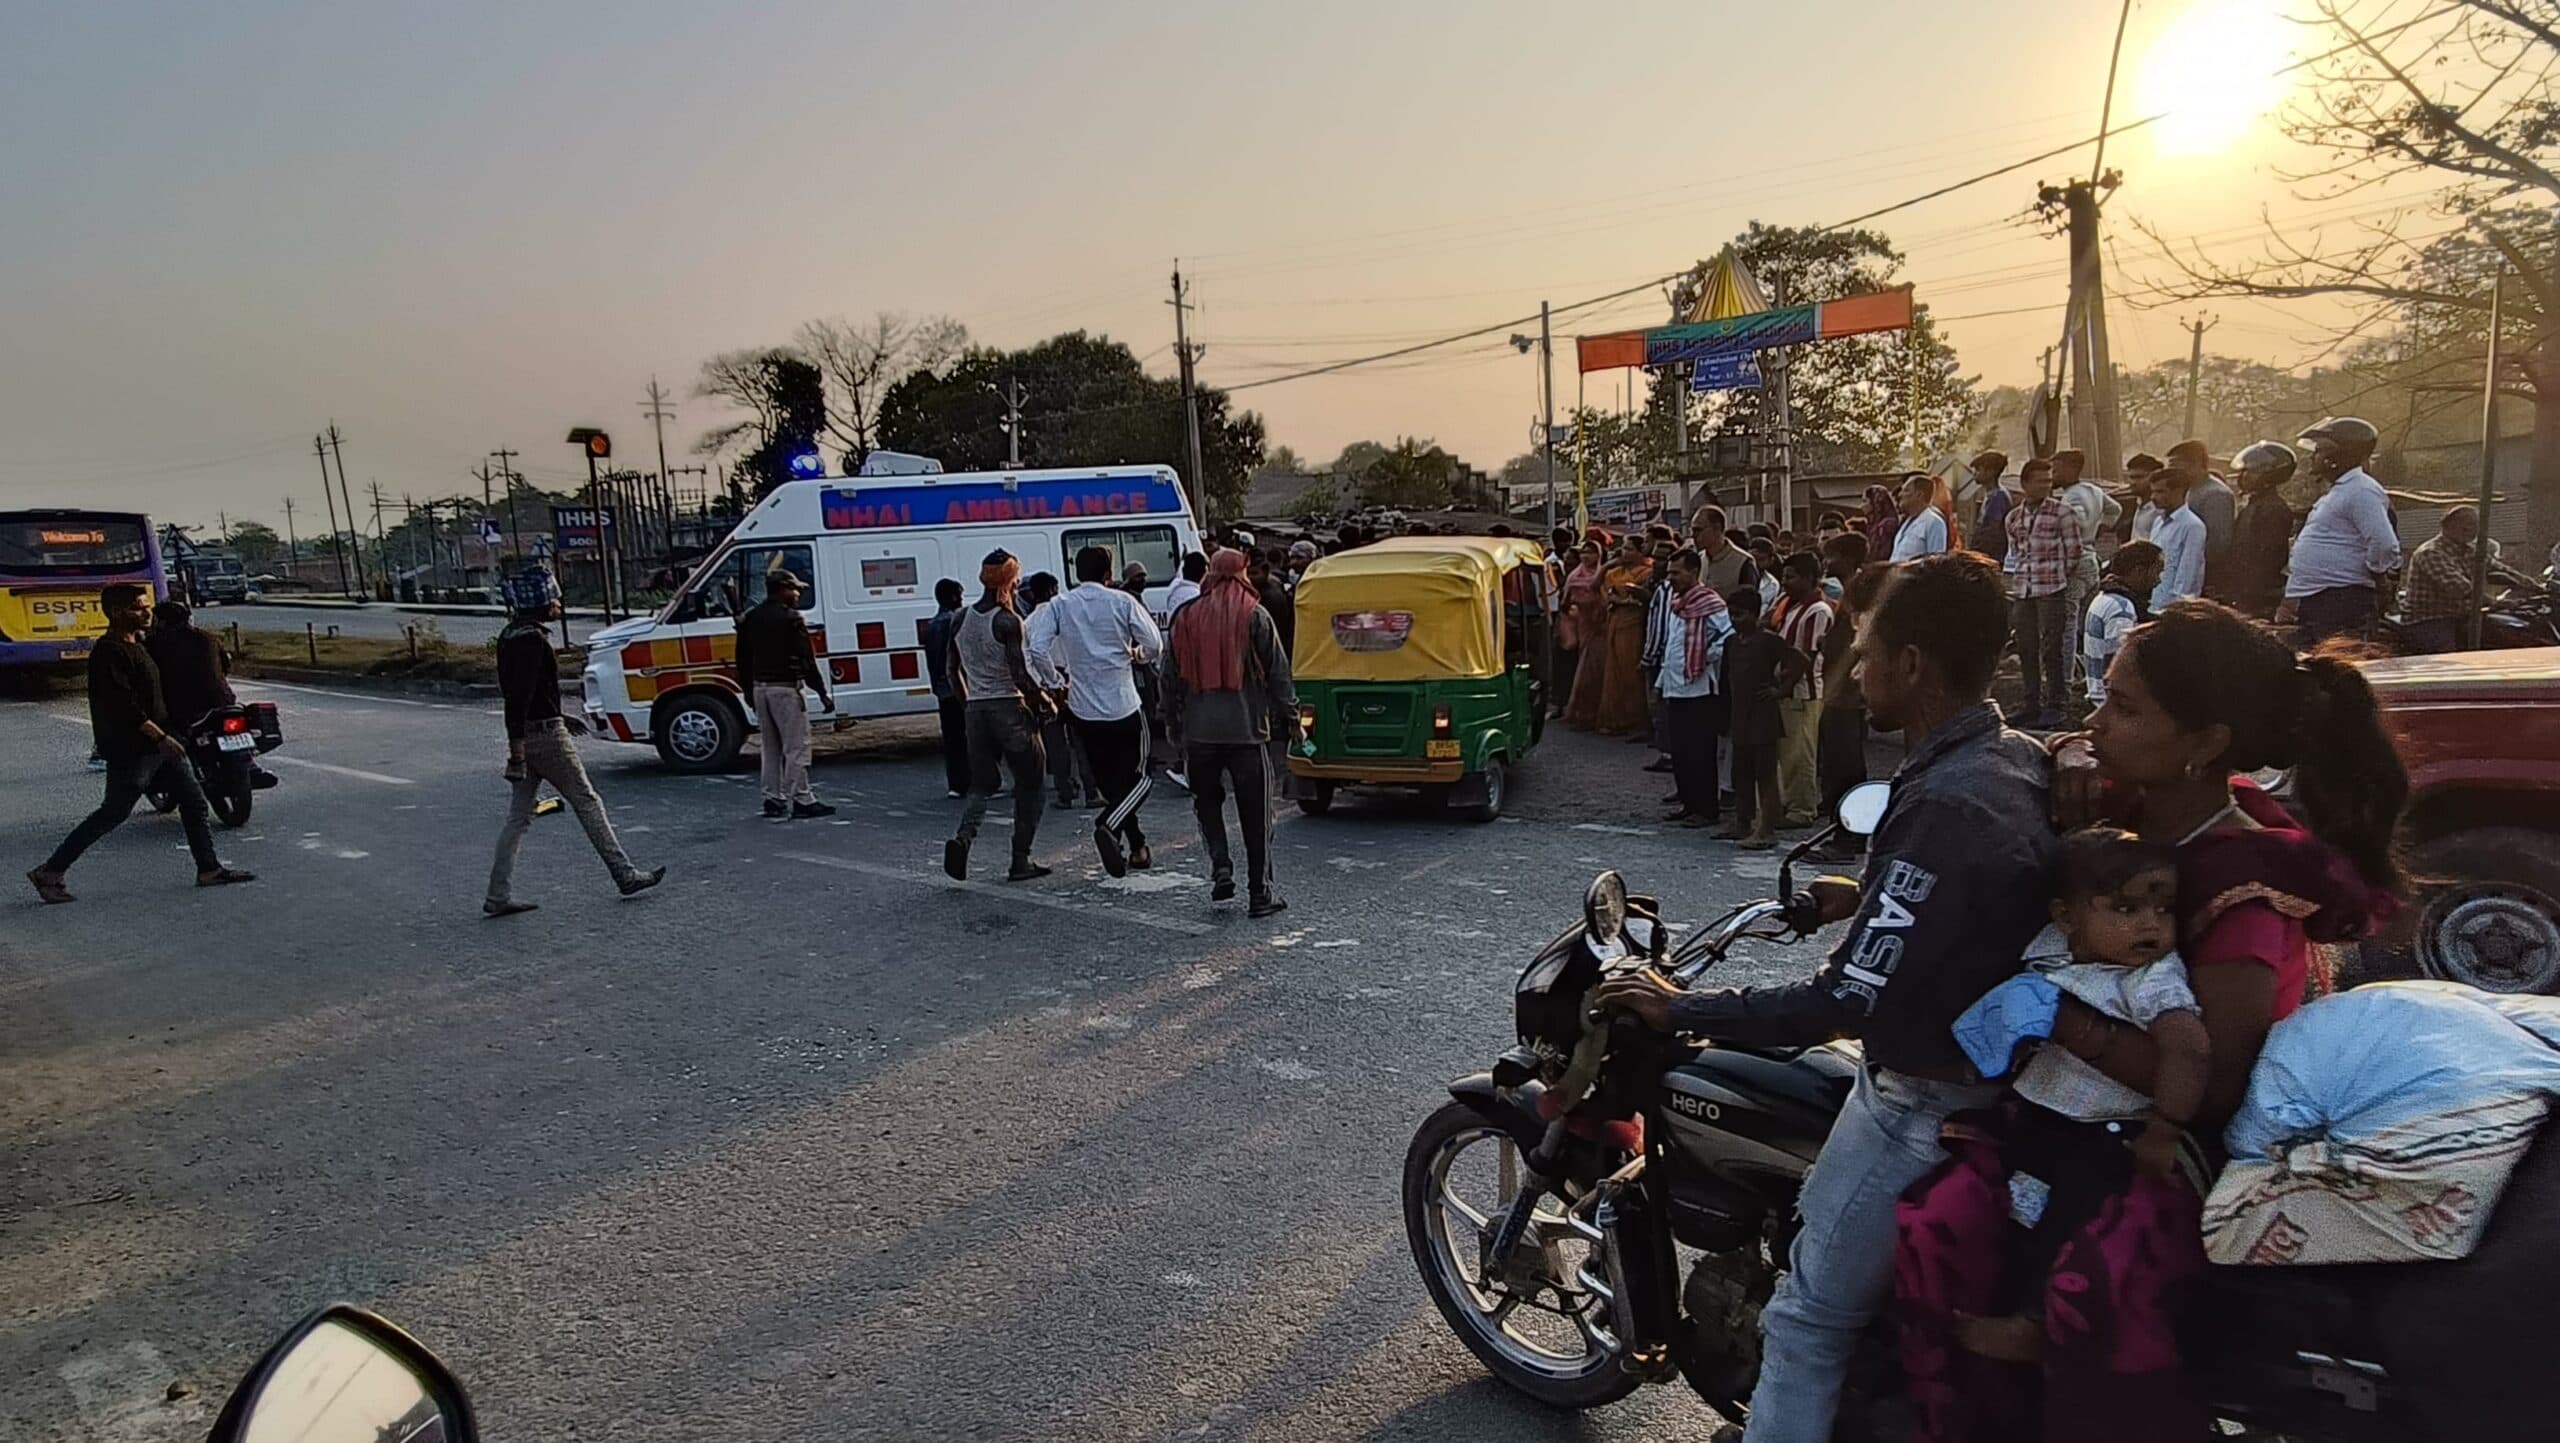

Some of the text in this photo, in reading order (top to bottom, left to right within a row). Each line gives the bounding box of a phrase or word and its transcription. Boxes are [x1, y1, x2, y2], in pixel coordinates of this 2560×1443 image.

[1648, 338, 1680, 354] IHHS
[558, 509, 612, 528] IHHS
[827, 491, 1150, 528] NHAI AMBULANCE
[90, 530, 105, 543] To
[1672, 1092, 1721, 1120] Hero
